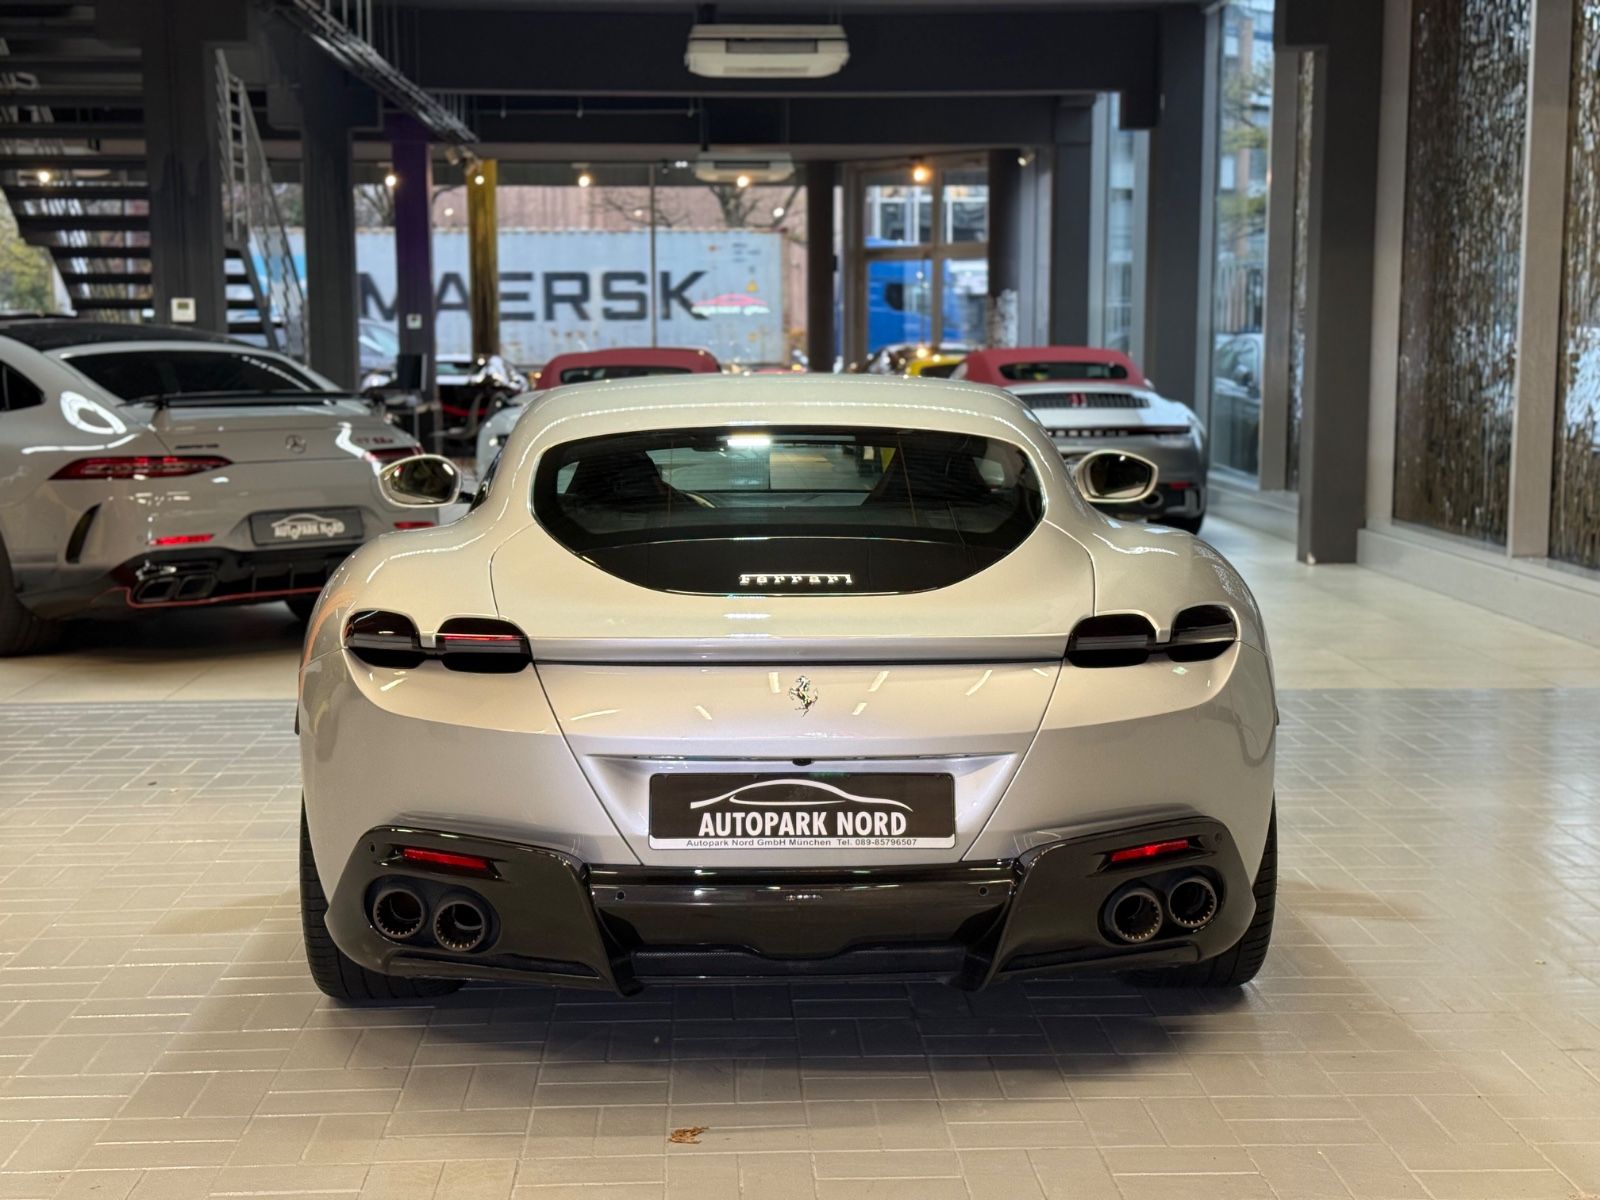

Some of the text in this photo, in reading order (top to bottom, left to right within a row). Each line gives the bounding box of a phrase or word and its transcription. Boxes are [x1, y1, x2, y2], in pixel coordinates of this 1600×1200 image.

[357, 271, 708, 321] MAERSK
[739, 573, 853, 586] Ferrari
[698, 811, 907, 837] AUTOPARK NORD
[686, 838, 918, 848] Autopark Nord GmbH München Tel. 089-85796507
